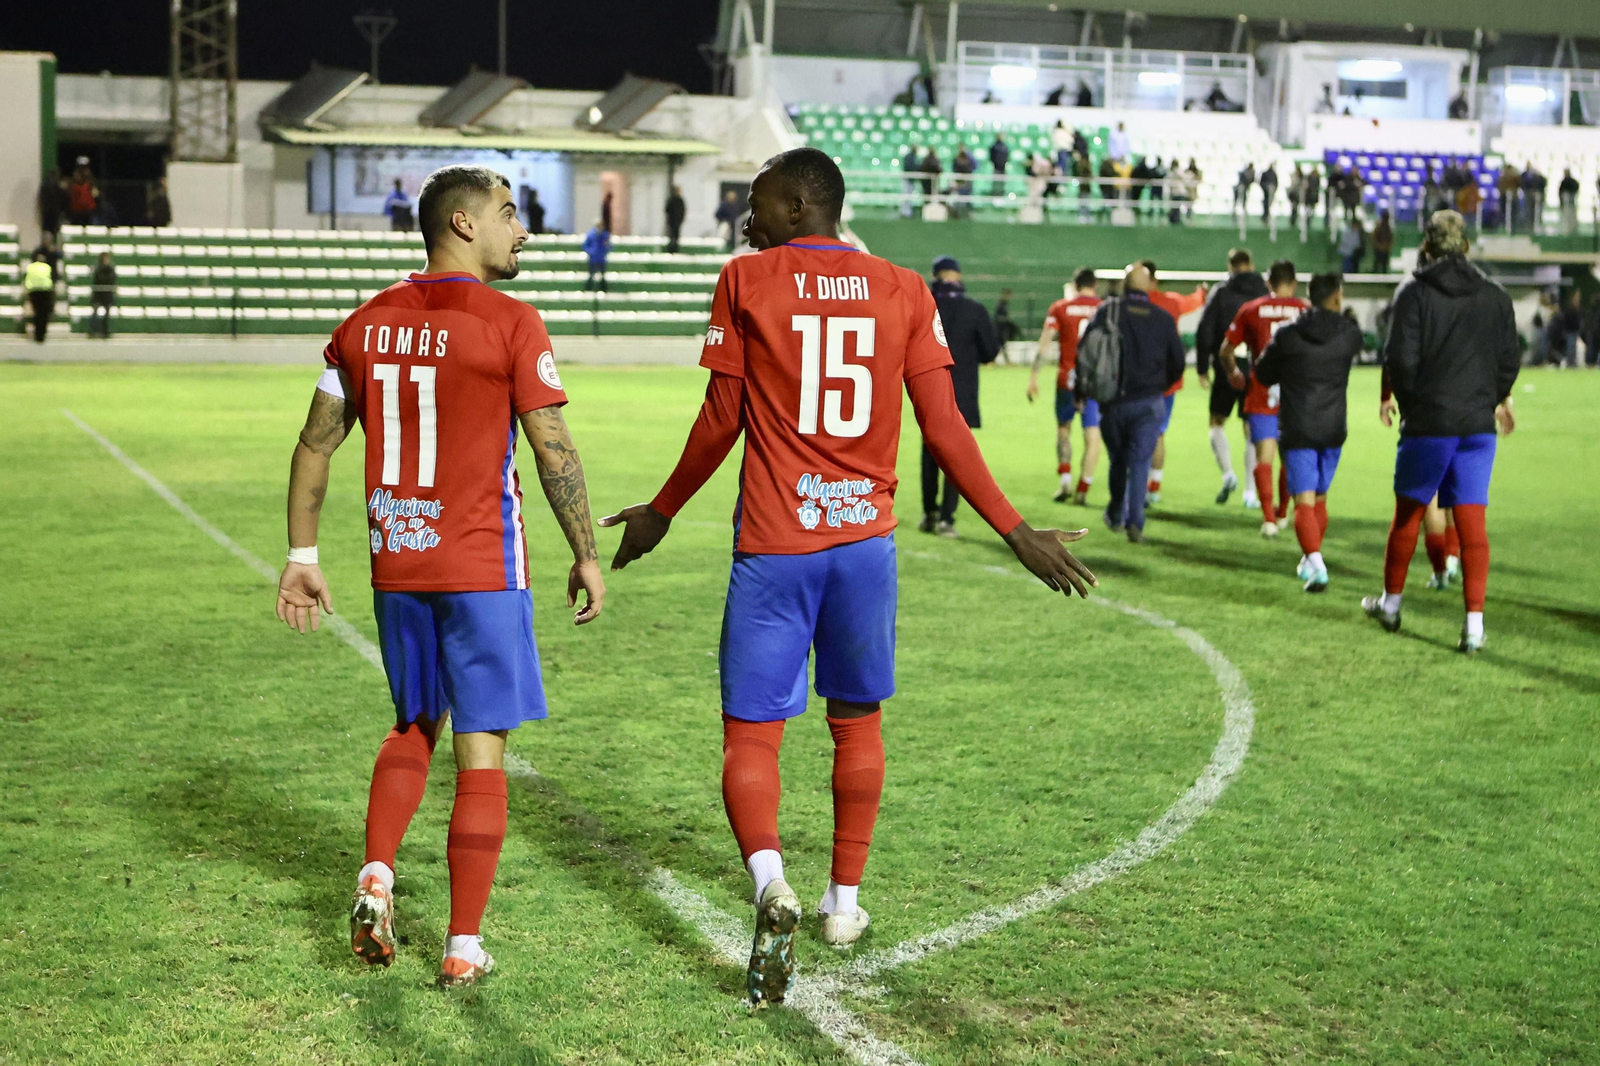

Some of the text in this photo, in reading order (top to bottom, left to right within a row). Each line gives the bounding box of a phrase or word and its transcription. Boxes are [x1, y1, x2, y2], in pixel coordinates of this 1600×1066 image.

[794, 273, 869, 300] Y. DIORI
[791, 315, 876, 438] 15
[373, 363, 437, 488] 11
[796, 472, 876, 506] Algeciras
[368, 487, 445, 529] Algeciras
[408, 517, 425, 530] me
[827, 499, 878, 528] Gusta
[387, 520, 441, 553] Gusta
